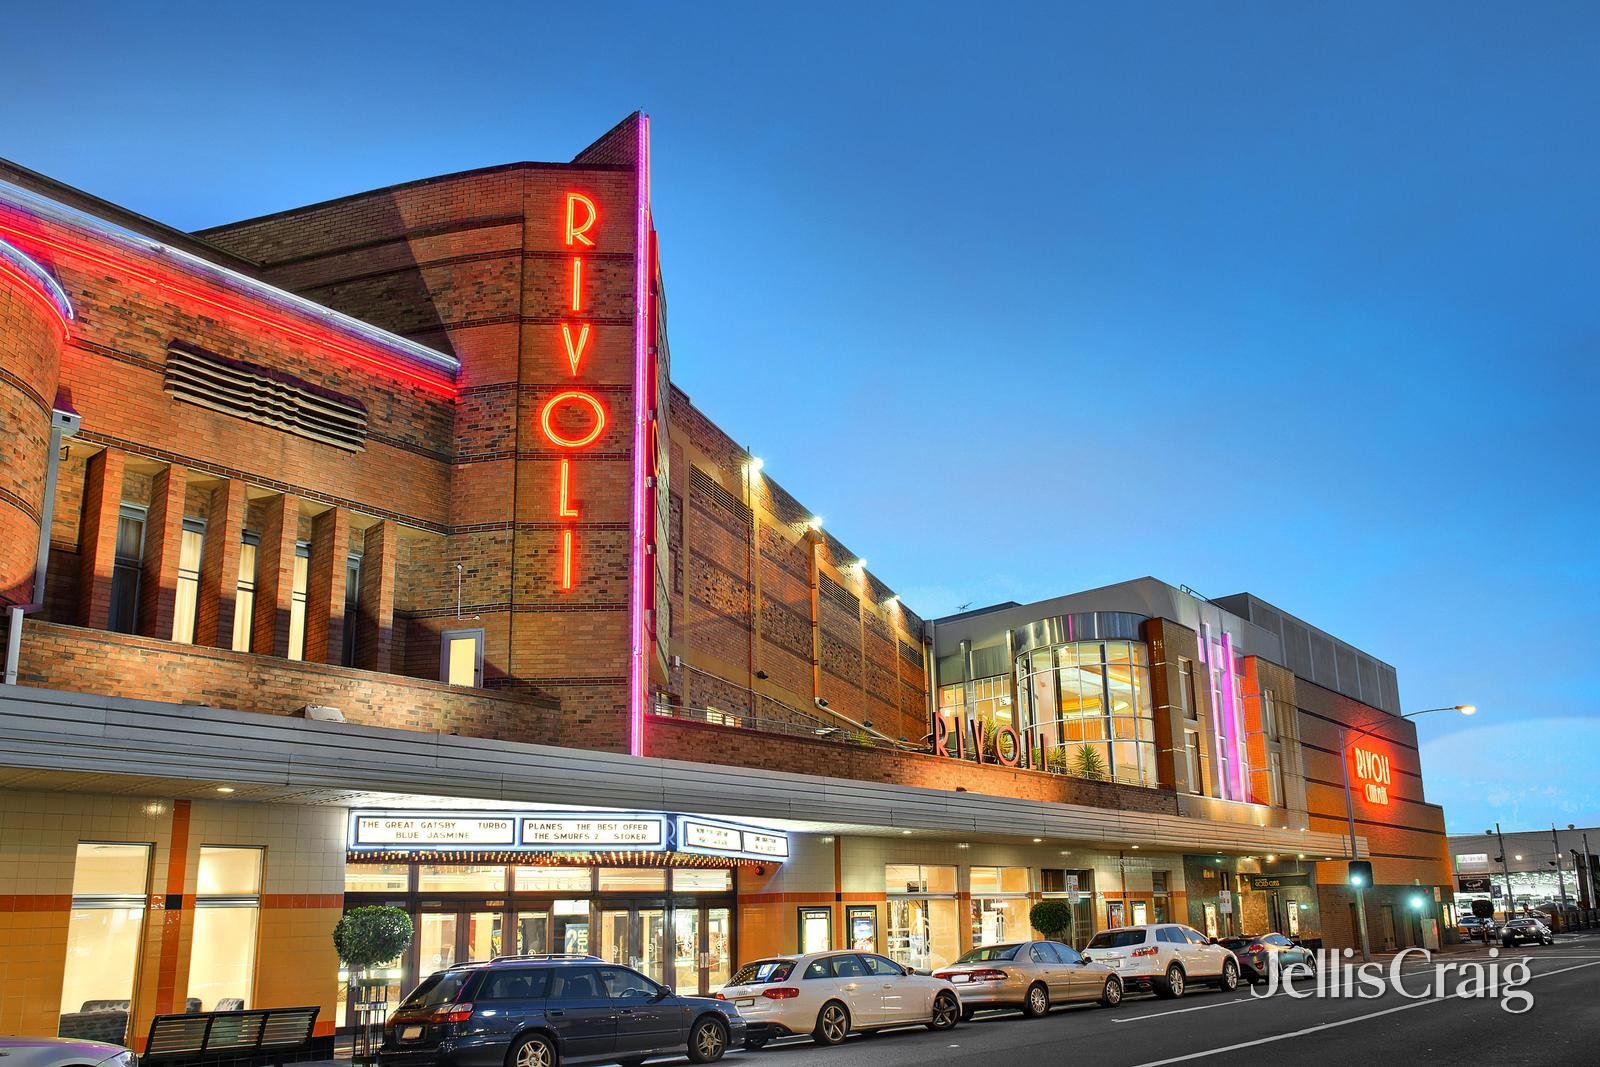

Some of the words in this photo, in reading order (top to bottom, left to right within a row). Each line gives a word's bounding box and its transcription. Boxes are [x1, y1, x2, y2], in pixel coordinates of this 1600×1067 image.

[540, 191, 606, 589] RIVOLI
[932, 711, 1049, 772] RIVOLI
[1354, 746, 1391, 785] RIVOLI
[362, 821, 380, 829] THE
[385, 821, 414, 829] GREAT
[420, 821, 456, 829] GATSBY
[478, 822, 508, 830] TURBO
[576, 823, 591, 831] THE
[597, 823, 618, 831] BEST
[395, 831, 419, 839] BLUE
[427, 831, 471, 839] JASMINE
[534, 832, 549, 840] THE
[554, 832, 590, 840] SMURFS
